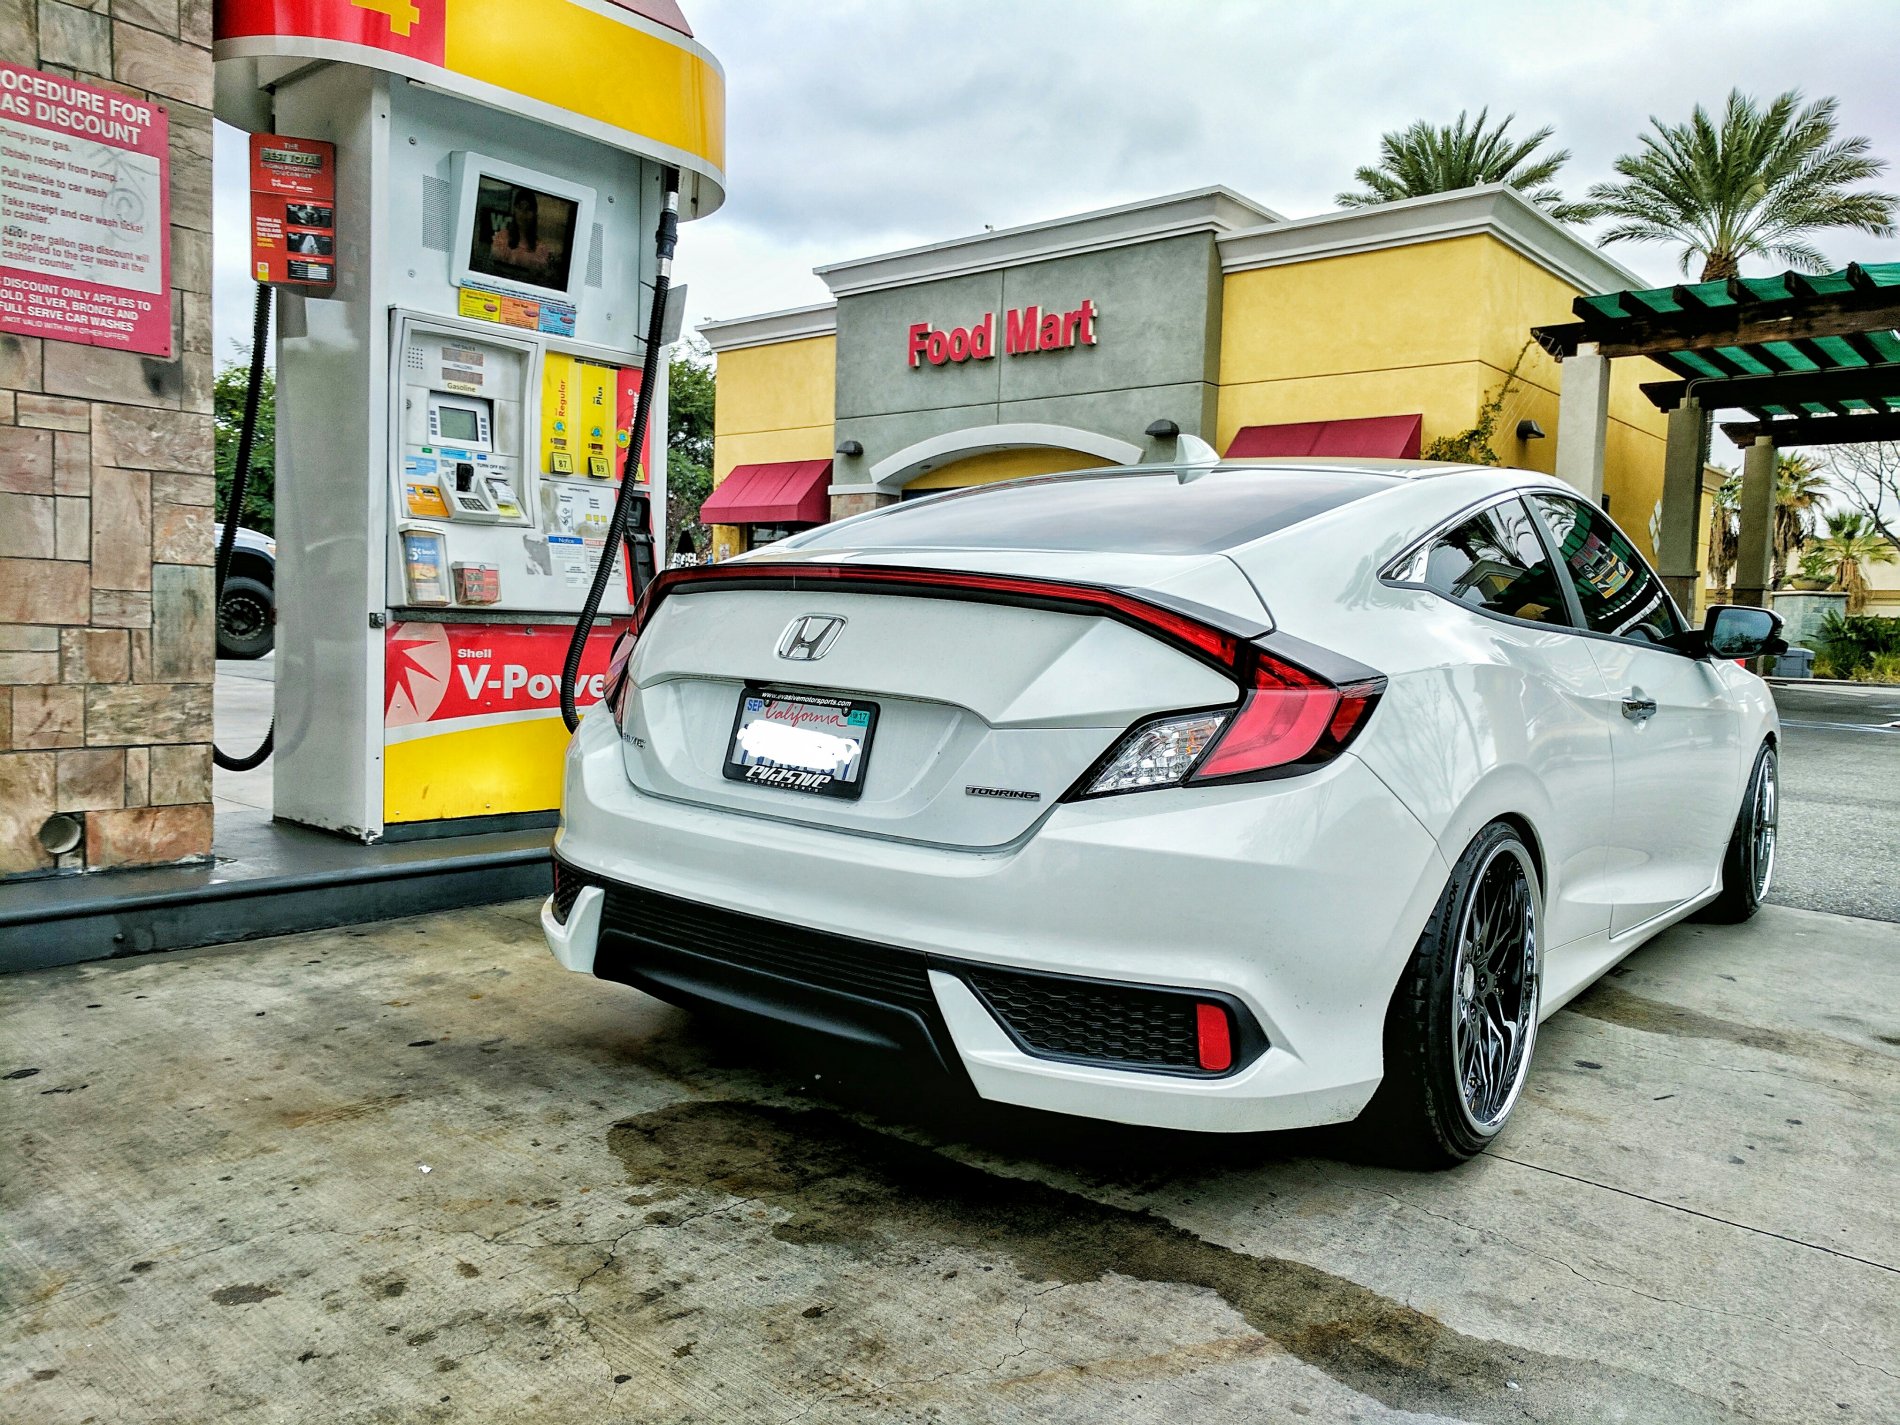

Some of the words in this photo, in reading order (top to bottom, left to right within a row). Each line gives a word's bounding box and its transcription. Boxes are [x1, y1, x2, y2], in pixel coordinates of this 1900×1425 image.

[0, 69, 105, 115] OCEDURE
[110, 99, 151, 127] FOR
[36, 101, 141, 146] DISCOUNT
[29, 134, 51, 145] your
[52, 140, 72, 152] gas.
[284, 143, 299, 151] THE
[34, 155, 66, 171] receipt
[68, 163, 89, 175] from
[90, 169, 118, 183] pump.
[262, 151, 287, 163] BEST
[289, 154, 321, 166] TOTAL
[2, 166, 20, 178] Pull
[22, 171, 54, 186] vehicle
[57, 179, 67, 188] to
[68, 183, 83, 193] car
[84, 186, 108, 198] wash
[2, 179, 39, 194] vacuum
[41, 187, 63, 200] area.
[2, 195, 25, 208] Take
[26, 201, 58, 215] receipt
[60, 208, 77, 219] and
[79, 213, 94, 223] car
[95, 216, 118, 228] wash
[120, 220, 144, 233] ticket
[2, 207, 12, 216] to
[14, 211, 51, 225] cashier.
[2, 237, 14, 248] be
[16, 241, 50, 255] applied
[52, 247, 62, 257] to
[64, 249, 79, 261] the
[80, 253, 94, 264] car
[96, 257, 119, 268] wash
[121, 261, 131, 271] at
[132, 263, 146, 273] the
[2, 251, 37, 263] cashier
[39, 257, 77, 271] counter.
[31, 232, 46, 243] per
[48, 237, 76, 250] gallon
[78, 243, 95, 254] gas
[96, 246, 134, 260] discount
[136, 254, 151, 264] will
[3, 277, 60, 296] DISCOUNT
[61, 286, 92, 301] ONLY
[92, 292, 136, 309] APPLIES
[137, 299, 152, 312] TO
[28, 293, 71, 311] SILVER,
[72, 300, 116, 318] BRONZE
[116, 309, 139, 321] AND
[28, 306, 65, 322] SERVE
[66, 313, 90, 326] CAR
[90, 316, 135, 333] WASHES
[908, 312, 998, 369] Food
[1005, 299, 1098, 356] Mart
[447, 382, 476, 392] Gasoline
[557, 379, 568, 418] Regular
[559, 459, 568, 469] 87
[457, 648, 492, 659] Shell
[457, 663, 605, 700] V-Powe
[747, 699, 763, 712] SEP
[765, 700, 847, 728] California
[761, 691, 852, 708] www.evasivemotorsports.com
[970, 787, 1040, 799] TOURING
